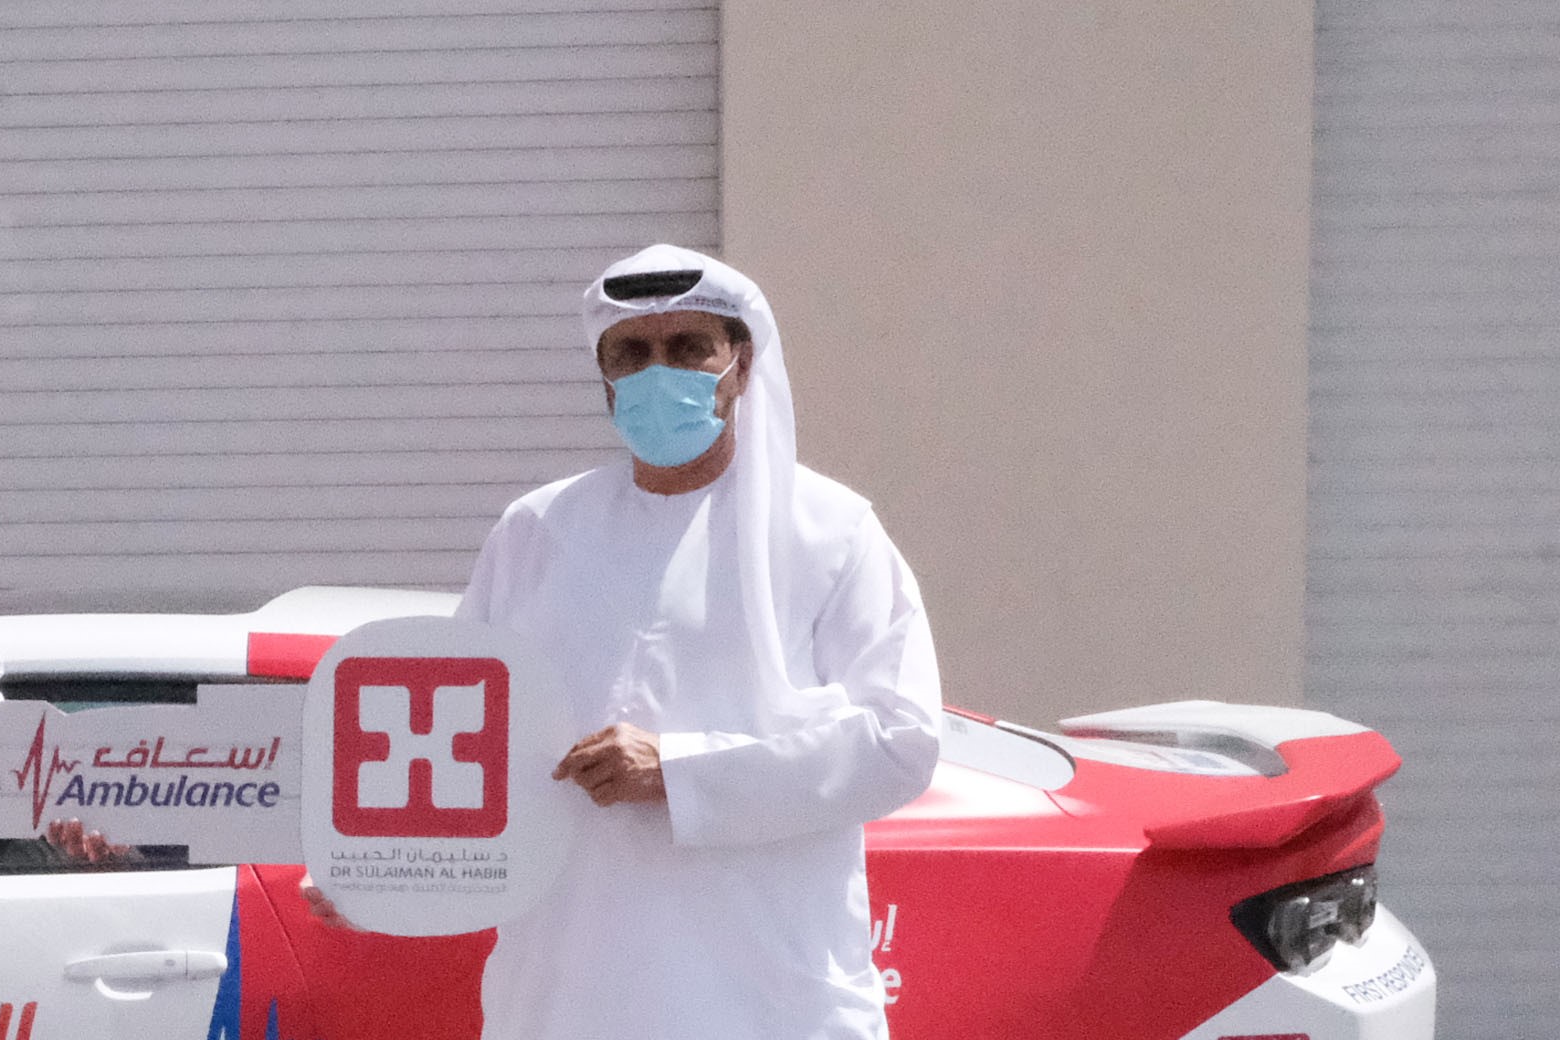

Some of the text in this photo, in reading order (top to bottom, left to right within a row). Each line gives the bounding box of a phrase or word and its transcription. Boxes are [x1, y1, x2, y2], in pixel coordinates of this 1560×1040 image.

[55, 774, 281, 807] Ambulance
[330, 866, 508, 879] DR SULAIMAN AL HABIB
[1342, 945, 1425, 1004] FIRST RESPONDE
